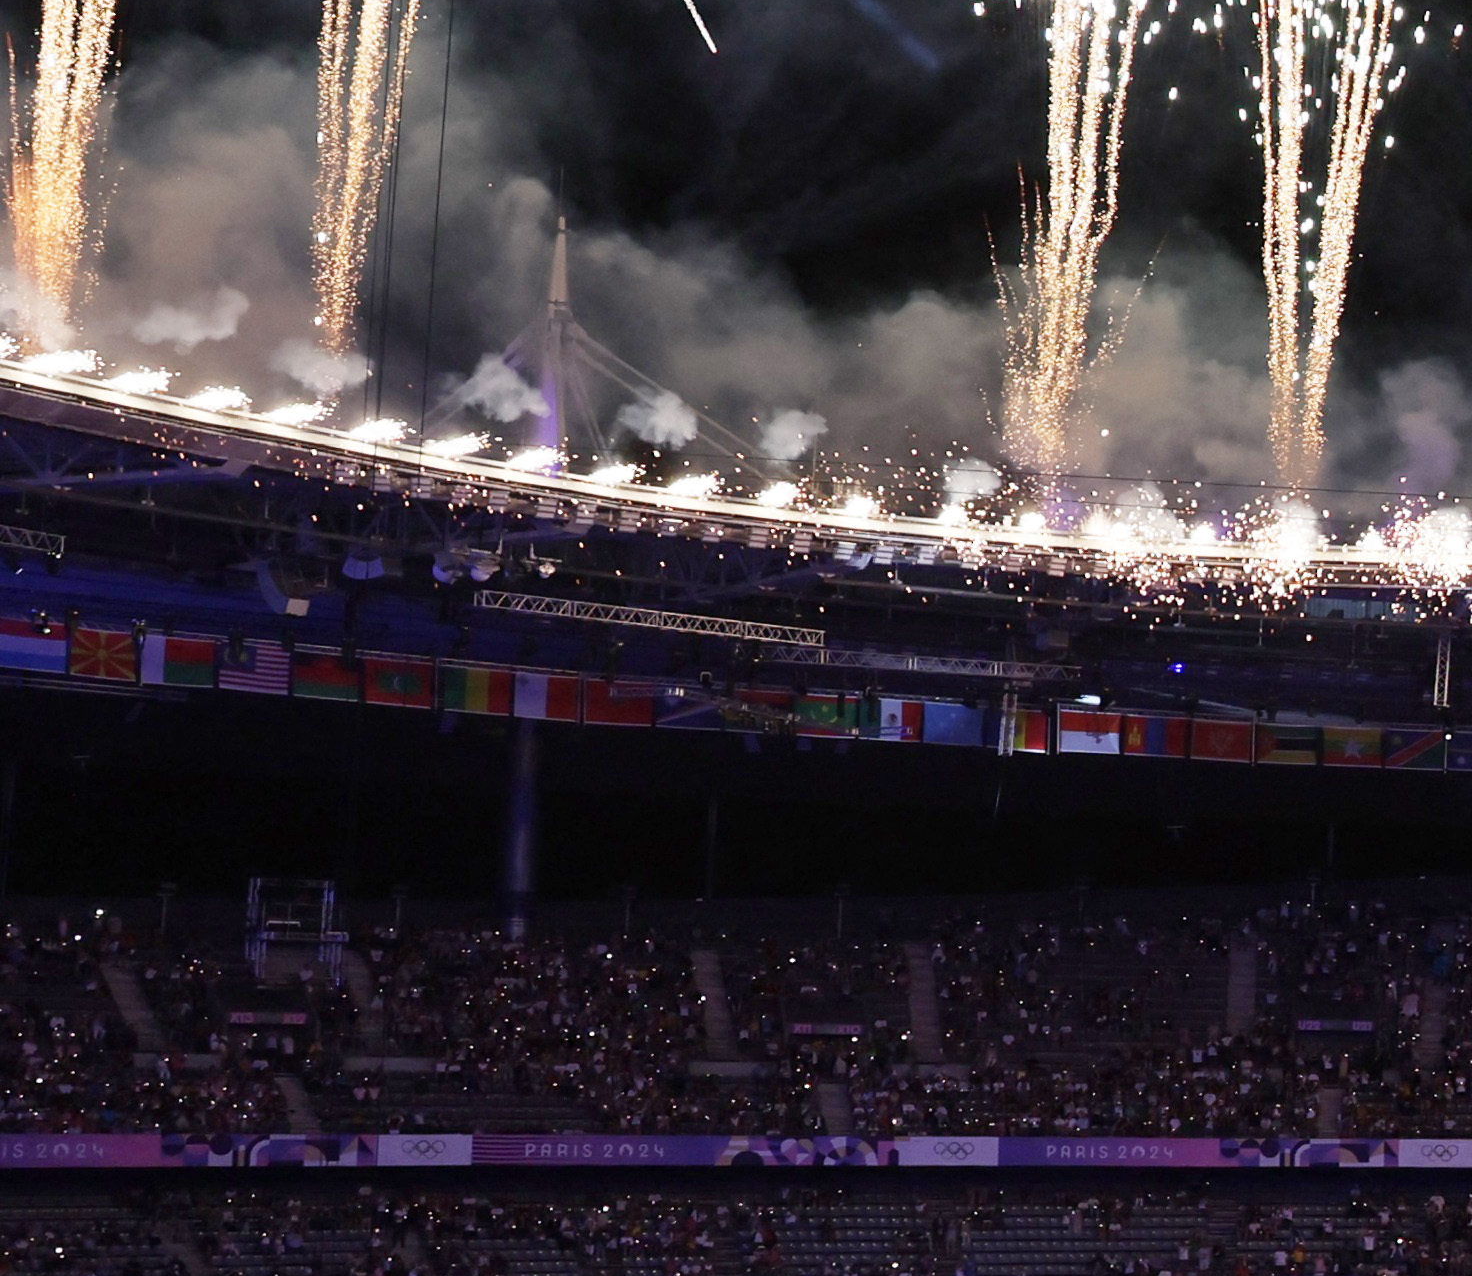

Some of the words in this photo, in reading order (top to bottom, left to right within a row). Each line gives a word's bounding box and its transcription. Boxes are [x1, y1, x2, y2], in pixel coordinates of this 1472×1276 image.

[37, 1144, 104, 1158] 2024
[525, 1144, 592, 1158] PARIS
[603, 1144, 664, 1158] 2024
[1046, 1145, 1109, 1159] PARIS
[1118, 1145, 1174, 1159] 2024
